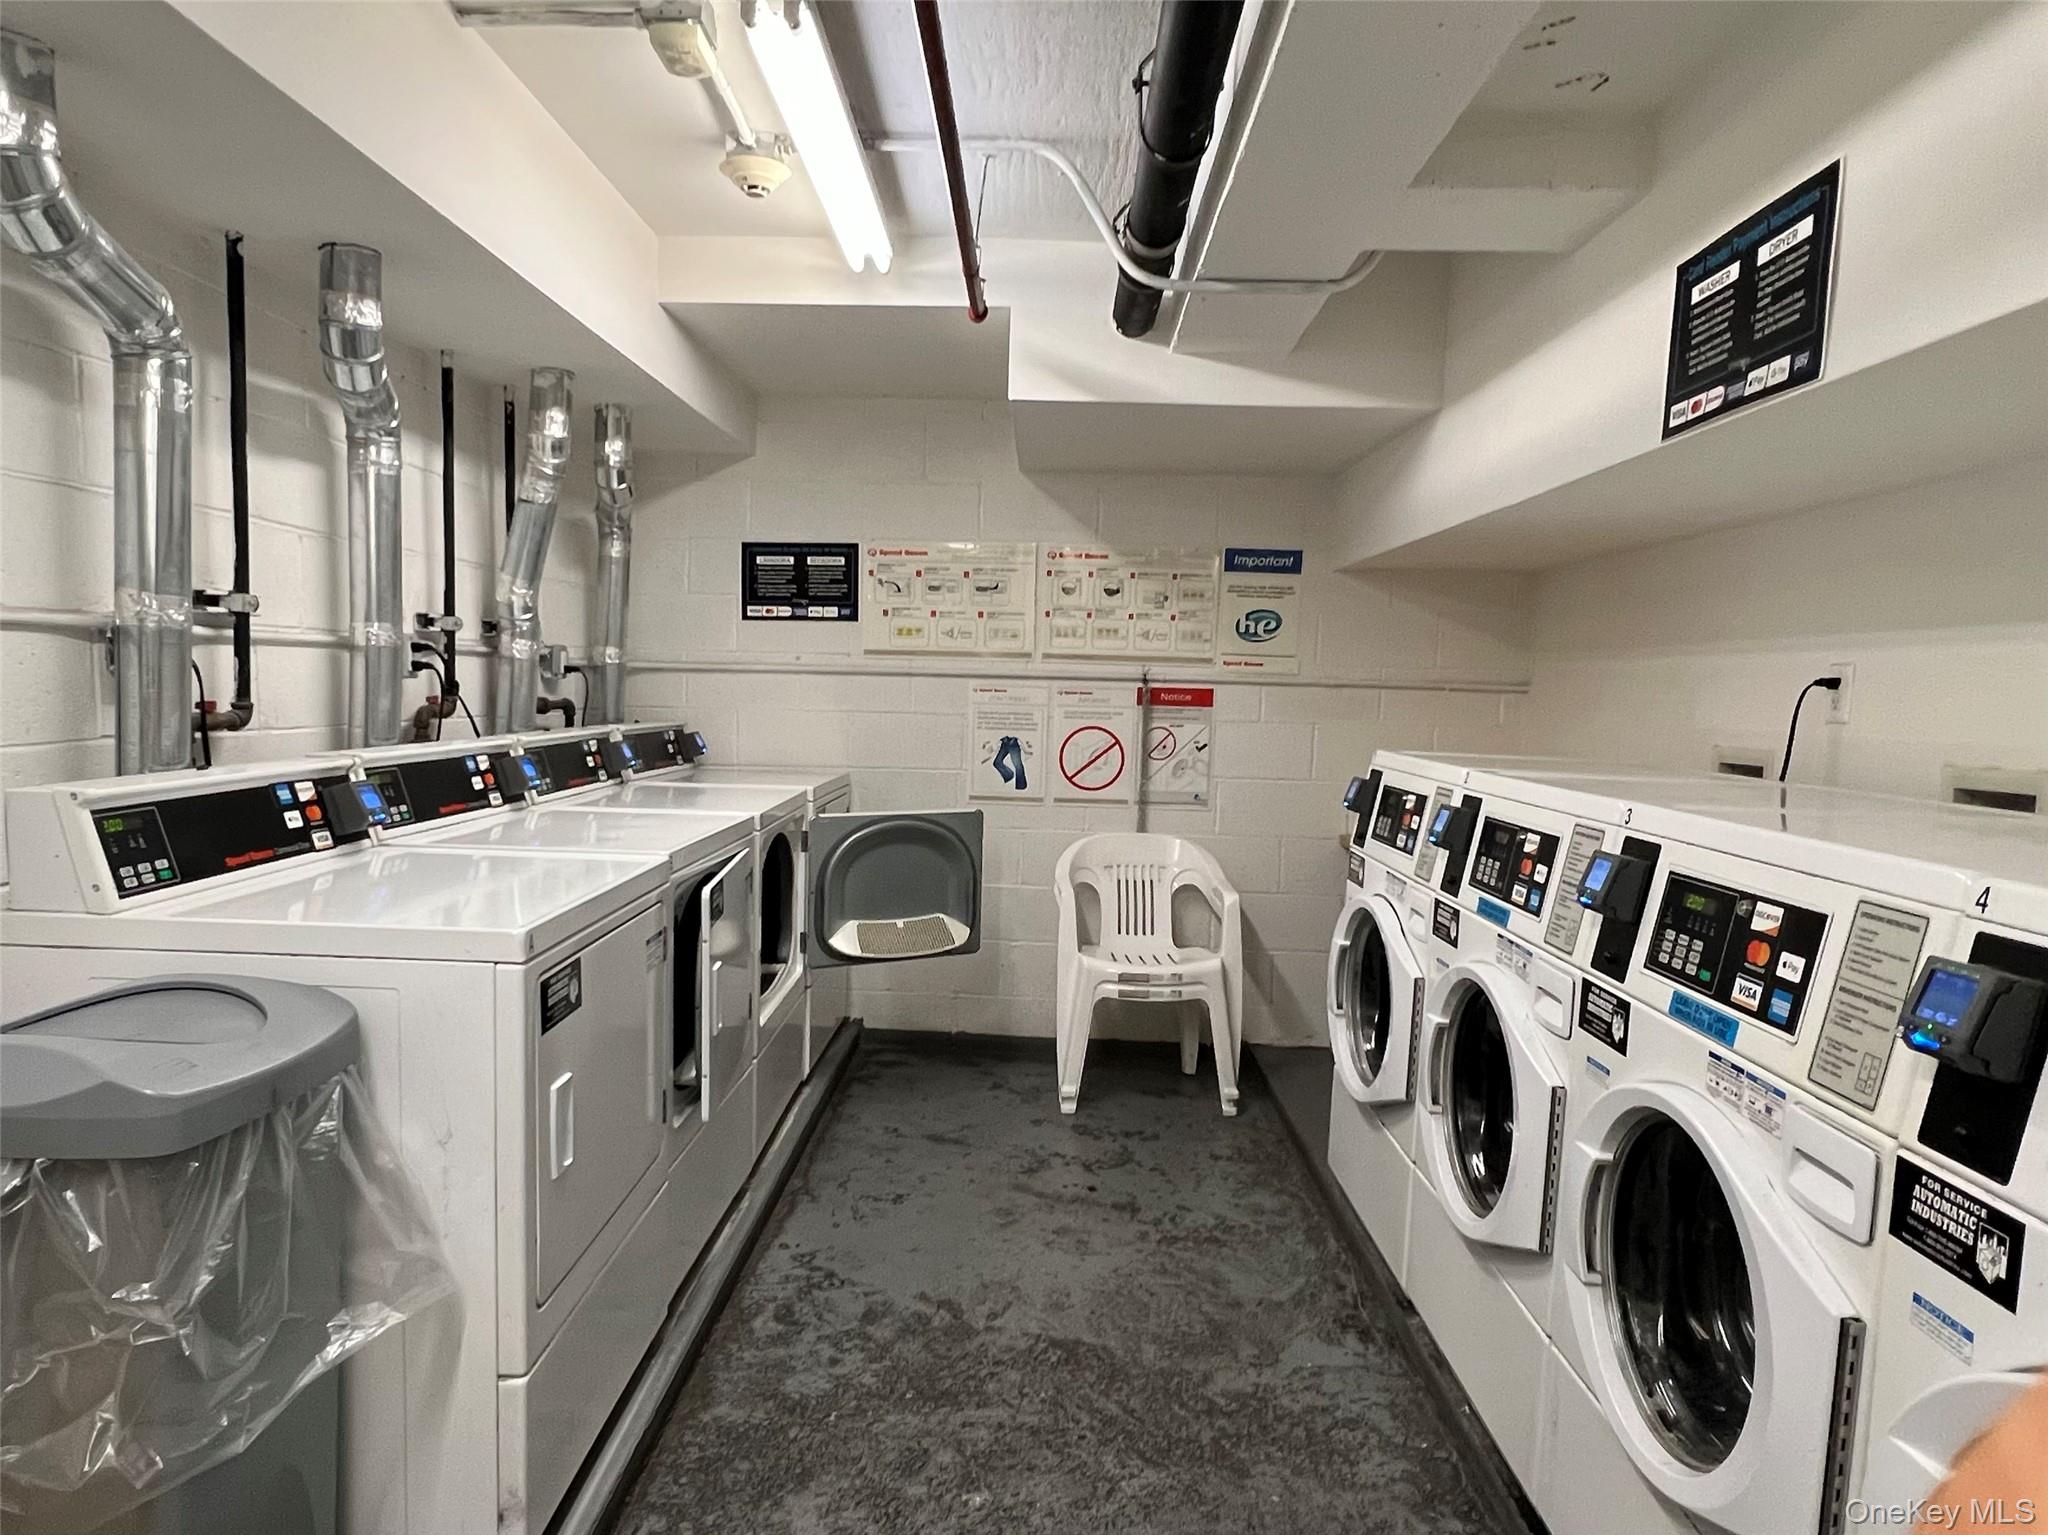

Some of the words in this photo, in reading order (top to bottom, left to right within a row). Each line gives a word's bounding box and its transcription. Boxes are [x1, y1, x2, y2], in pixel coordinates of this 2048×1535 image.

[1769, 228, 1799, 257] DRYER
[1697, 270, 1732, 297] WASHER
[1234, 554, 1294, 568] Important
[1239, 612, 1280, 638] he
[1160, 692, 1193, 702] Notice
[1624, 808, 1633, 825] 3
[1975, 886, 1991, 914] 4
[1788, 961, 1800, 976] Pay
[1738, 983, 1758, 1001] VISA
[1912, 1184, 1978, 1231] AUTOMATIC
[1921, 1175, 1942, 1194] FOR
[1943, 1187, 1988, 1220] SERVICE
[1910, 1198, 1976, 1247] INDUSTRIES
